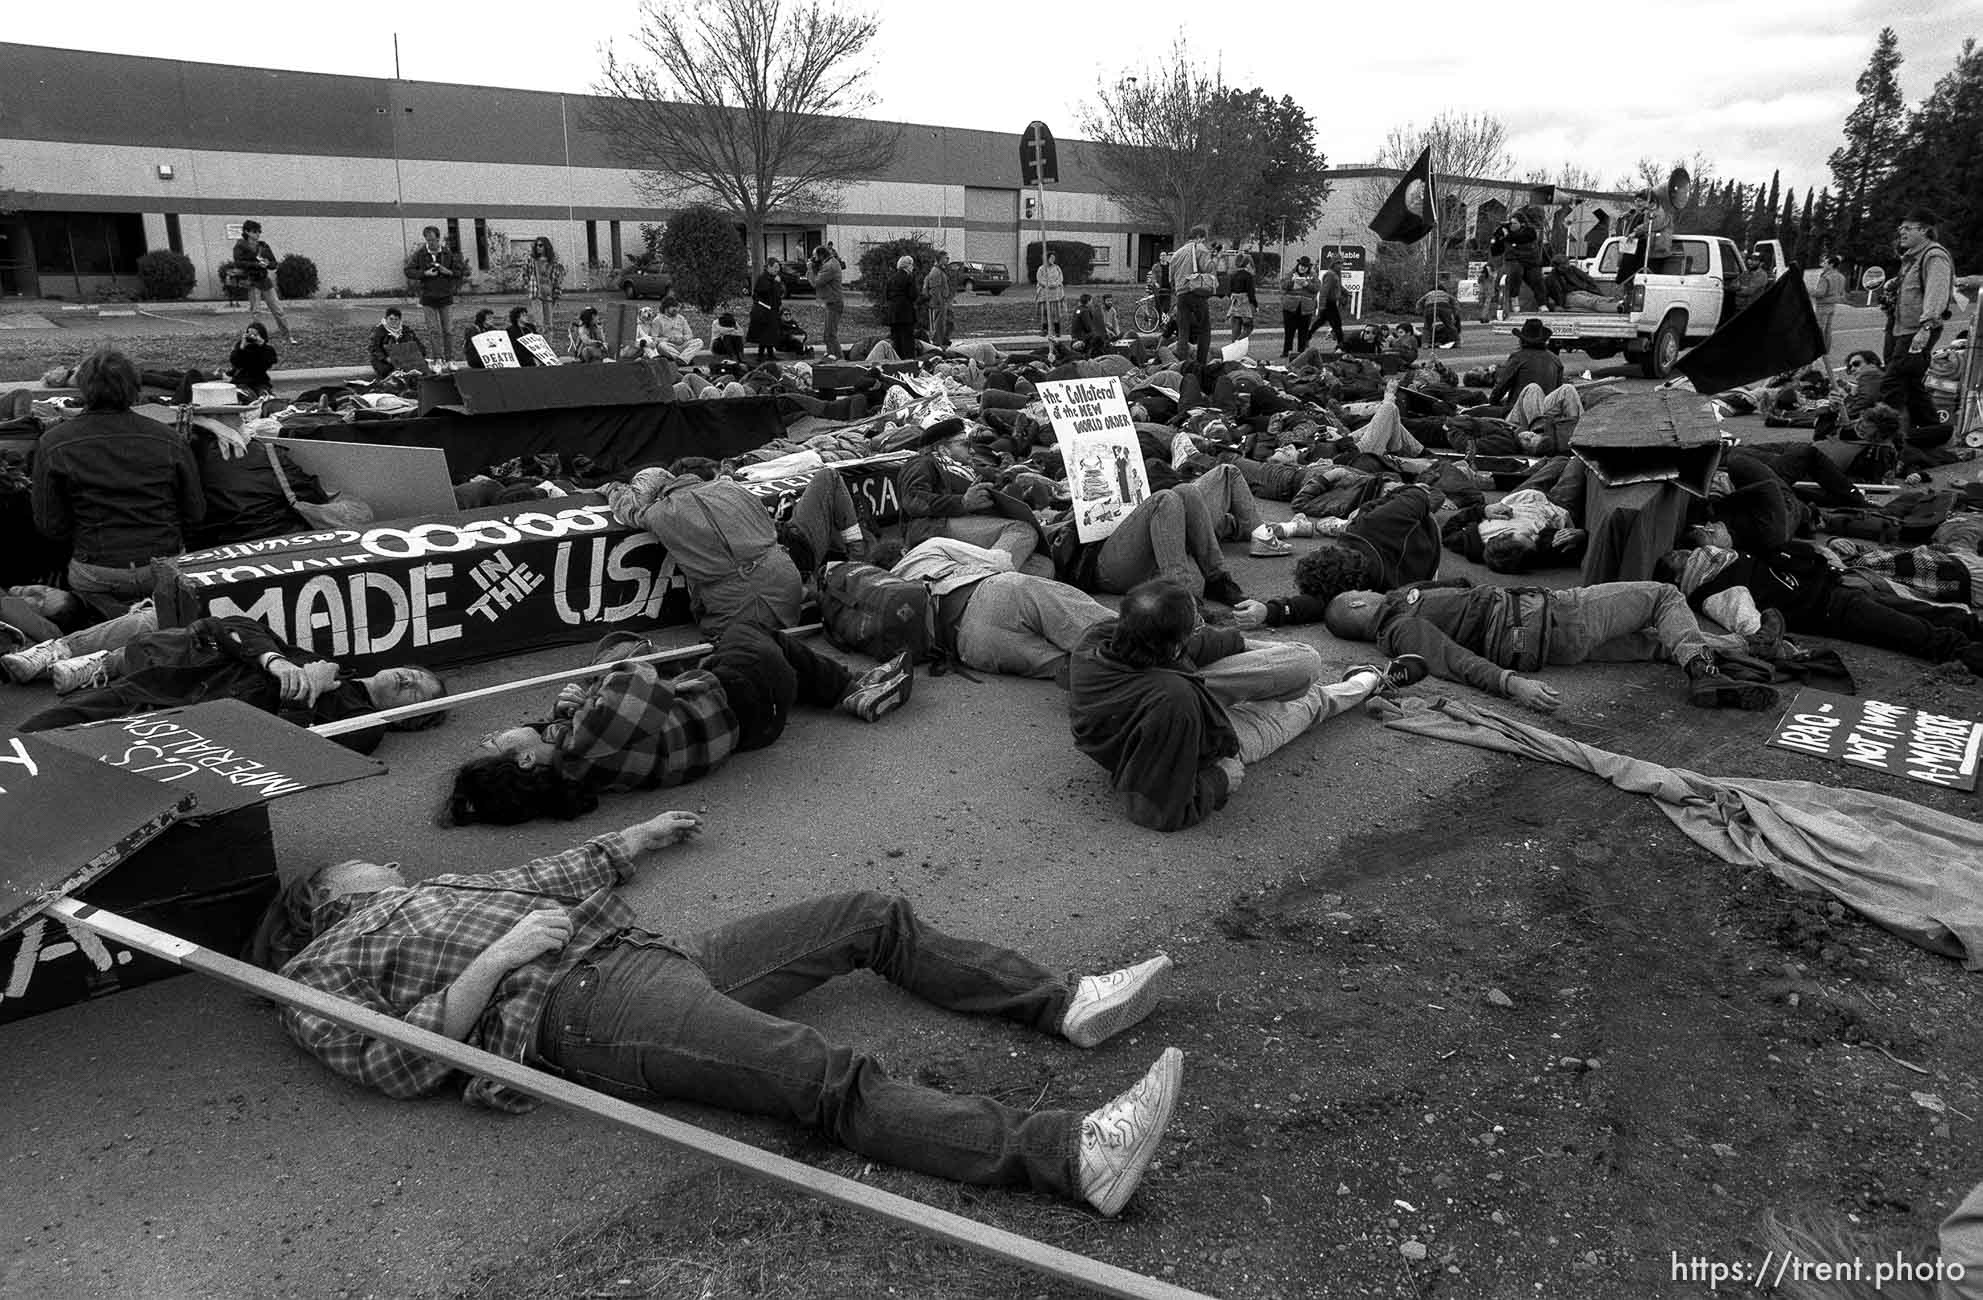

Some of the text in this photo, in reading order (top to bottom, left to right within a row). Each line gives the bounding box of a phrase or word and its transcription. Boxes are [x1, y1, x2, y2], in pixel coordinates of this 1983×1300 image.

[481, 352, 515, 364] DEATH
[1043, 388, 1062, 404] the
[1053, 403, 1102, 419] of the NEW
[1073, 414, 1131, 434] WORLD ORDER
[465, 561, 545, 622] THE
[468, 549, 514, 591] IN
[554, 532, 685, 624] USA
[209, 562, 463, 656] MADE
[80, 712, 307, 797] IMPERIALISM
[1843, 700, 1909, 768] NOT A WAR
